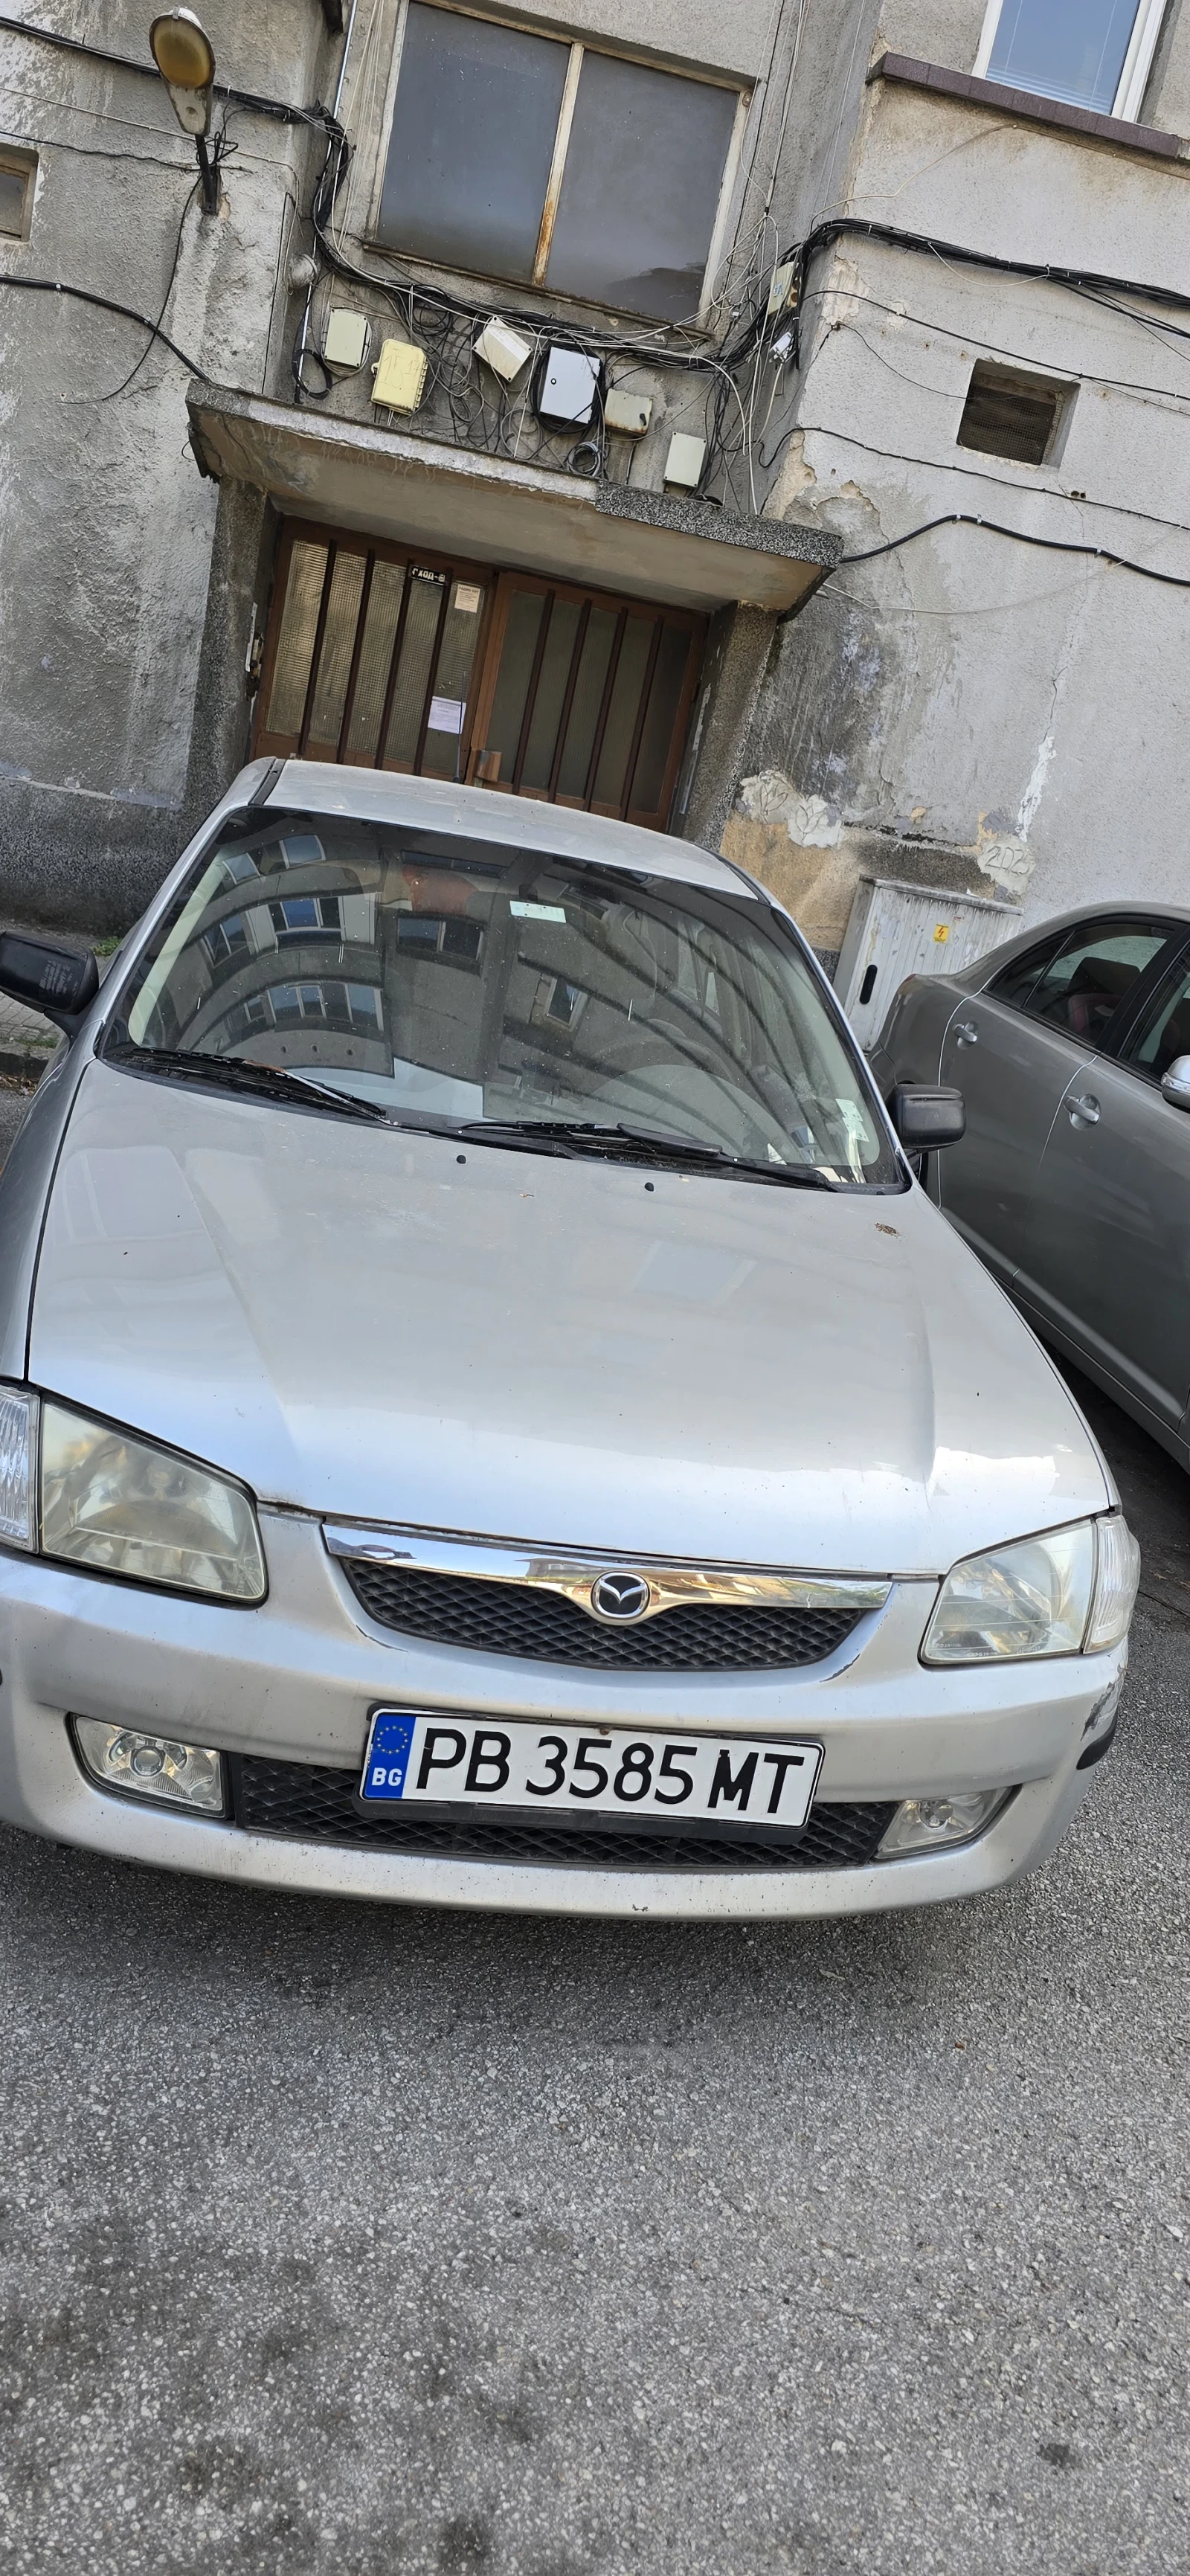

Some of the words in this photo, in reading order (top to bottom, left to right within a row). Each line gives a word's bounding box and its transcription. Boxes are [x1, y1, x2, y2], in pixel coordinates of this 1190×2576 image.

[372, 1767, 402, 1787] BG
[416, 1728, 511, 1792] PB
[526, 1736, 698, 1805] 3585
[707, 1750, 805, 1814] MT
